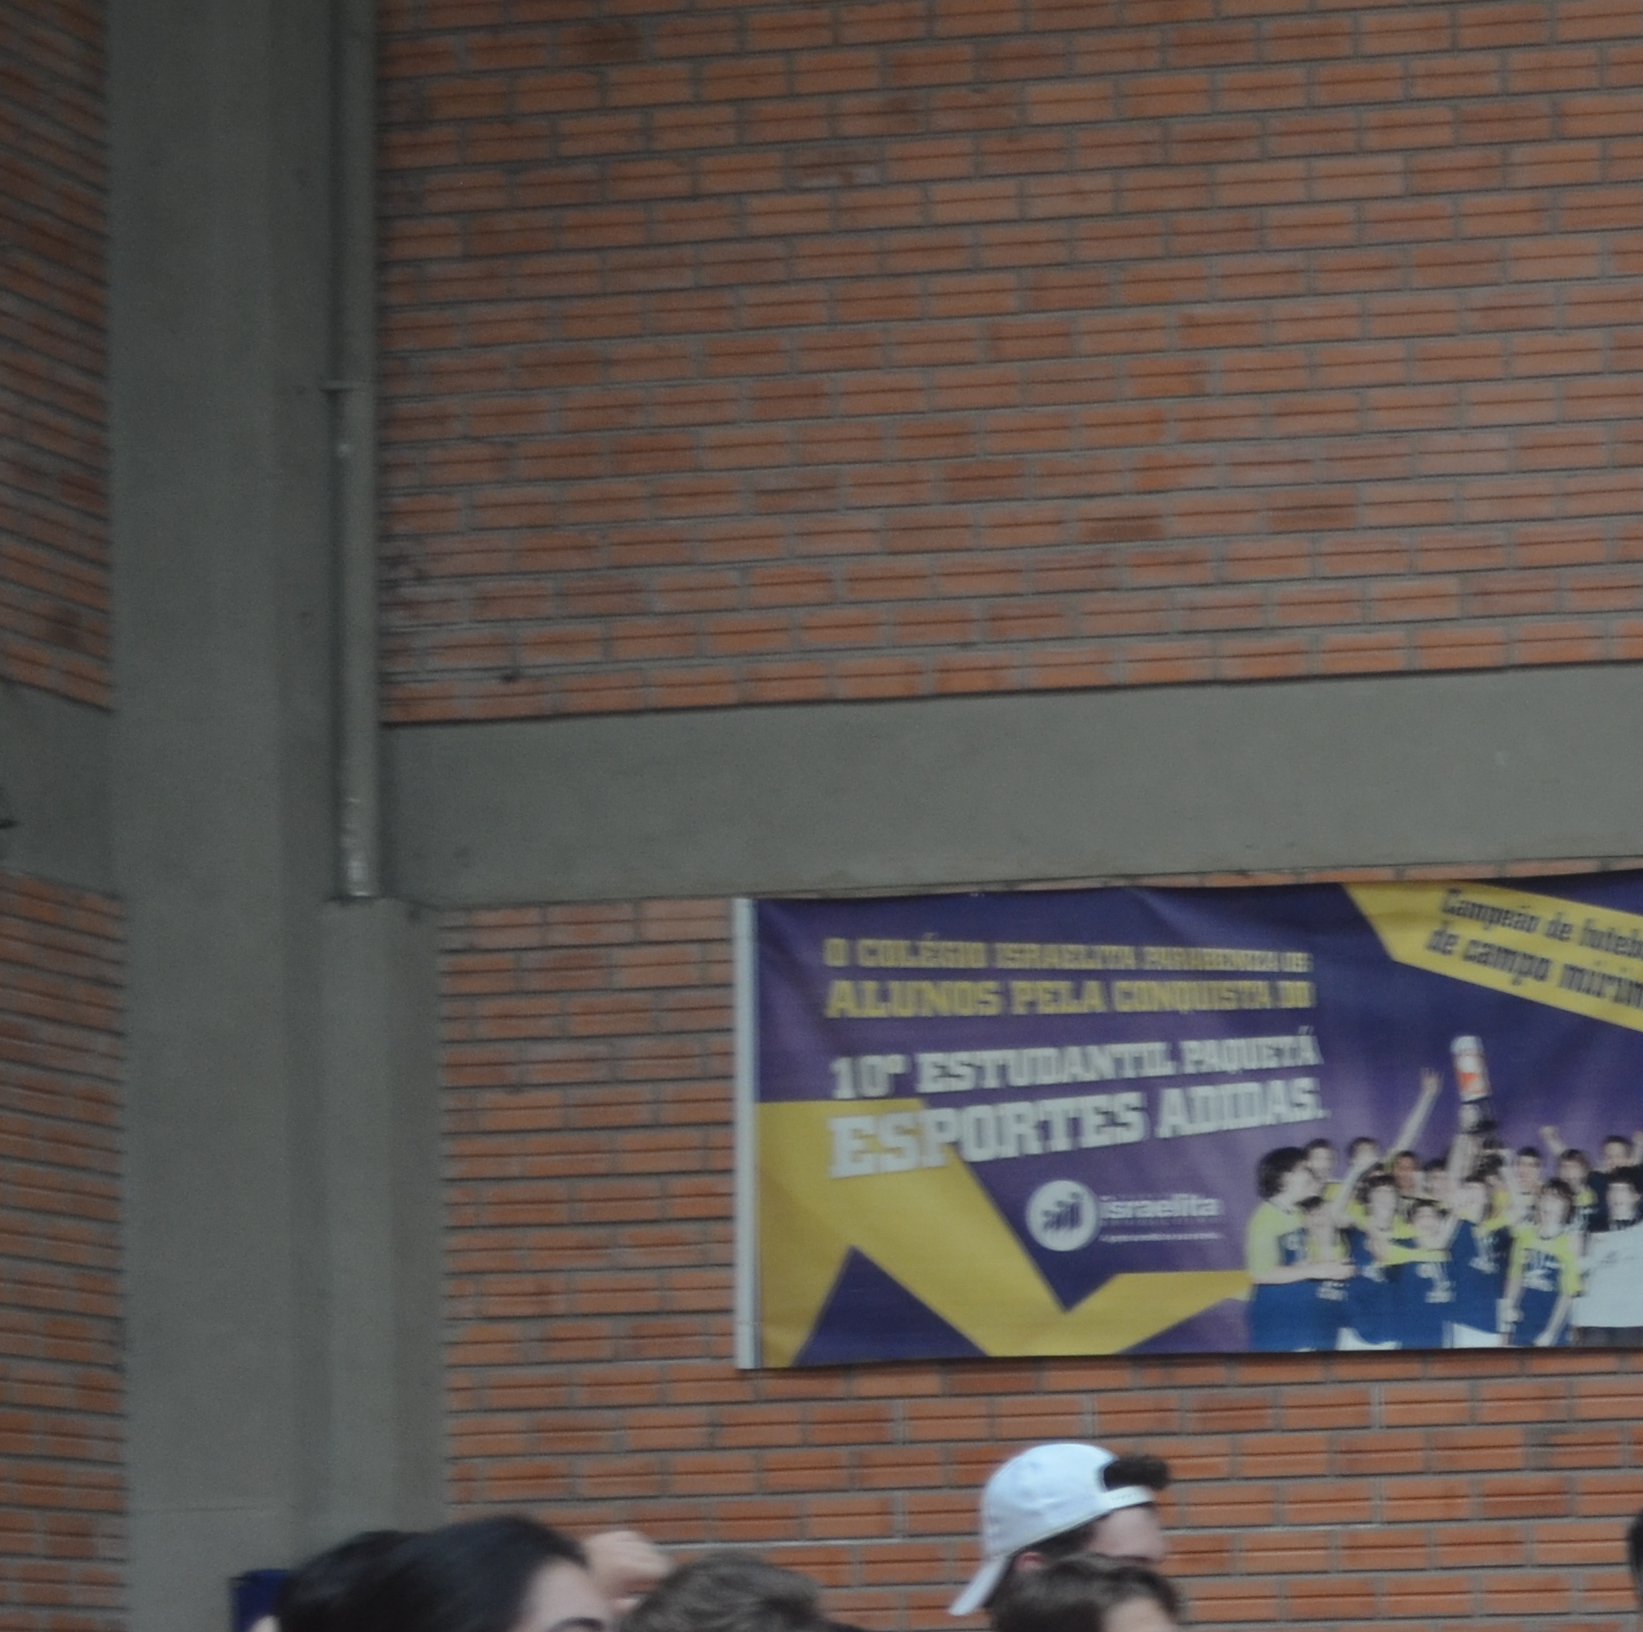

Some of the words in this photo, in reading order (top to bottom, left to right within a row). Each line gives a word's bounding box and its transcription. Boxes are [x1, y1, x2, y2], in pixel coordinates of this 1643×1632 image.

[1544, 912, 1574, 942] de
[1425, 921, 1459, 956] de
[1461, 938, 1554, 987] campo
[824, 979, 1003, 1018] ALUNOS
[1008, 979, 1108, 1015] PELA
[916, 1041, 1178, 1093] ESTUDANTIL
[828, 1091, 1147, 1180] ESPORTES
